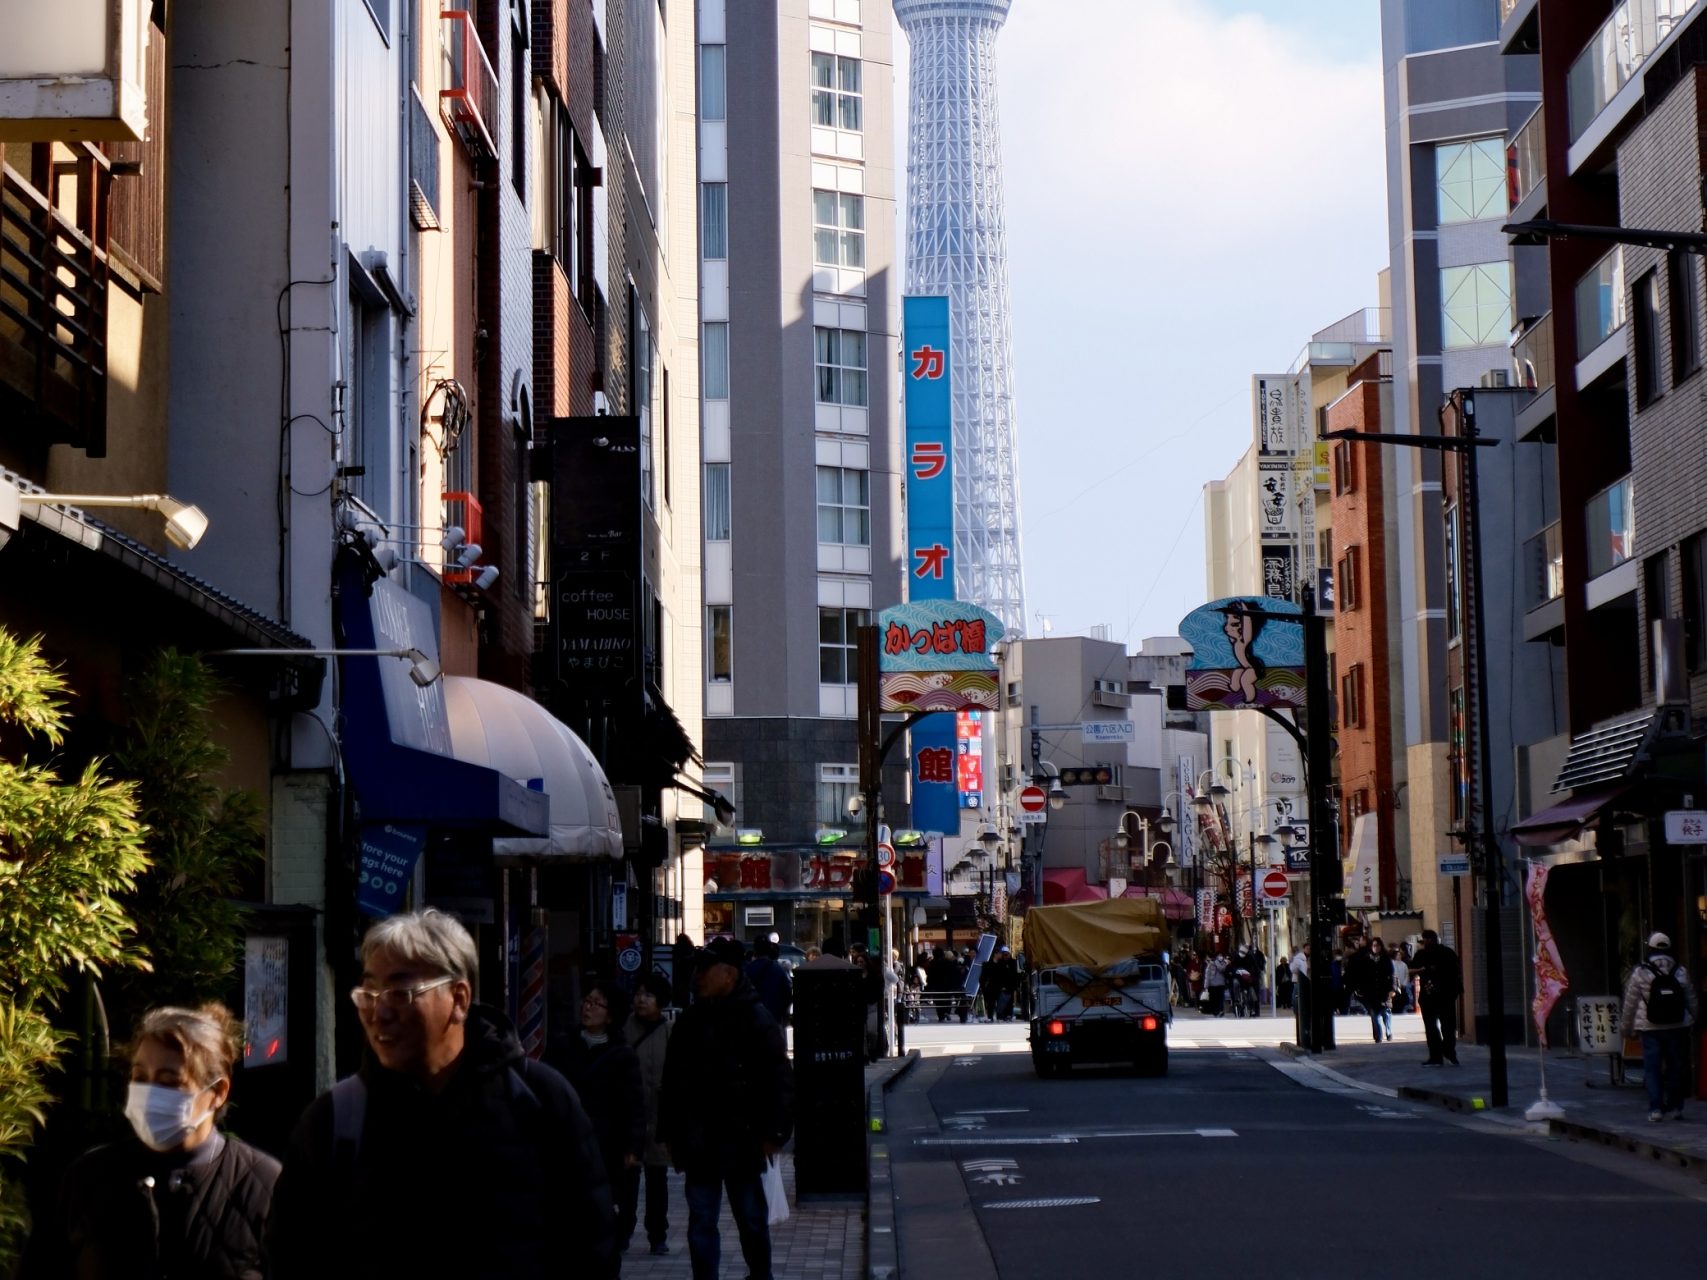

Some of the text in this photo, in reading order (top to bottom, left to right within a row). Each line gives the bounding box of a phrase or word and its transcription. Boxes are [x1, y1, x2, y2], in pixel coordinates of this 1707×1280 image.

[561, 590, 614, 602] coffee
[587, 608, 631, 620] HOUSE
[884, 618, 987, 656] かっぱ橋
[561, 638, 632, 651] YAMABIKO
[567, 656, 625, 670] やまびこ
[384, 851, 409, 867] your
[878, 851, 889, 861] 30
[1290, 849, 1311, 863] TX
[379, 862, 404, 879] here
